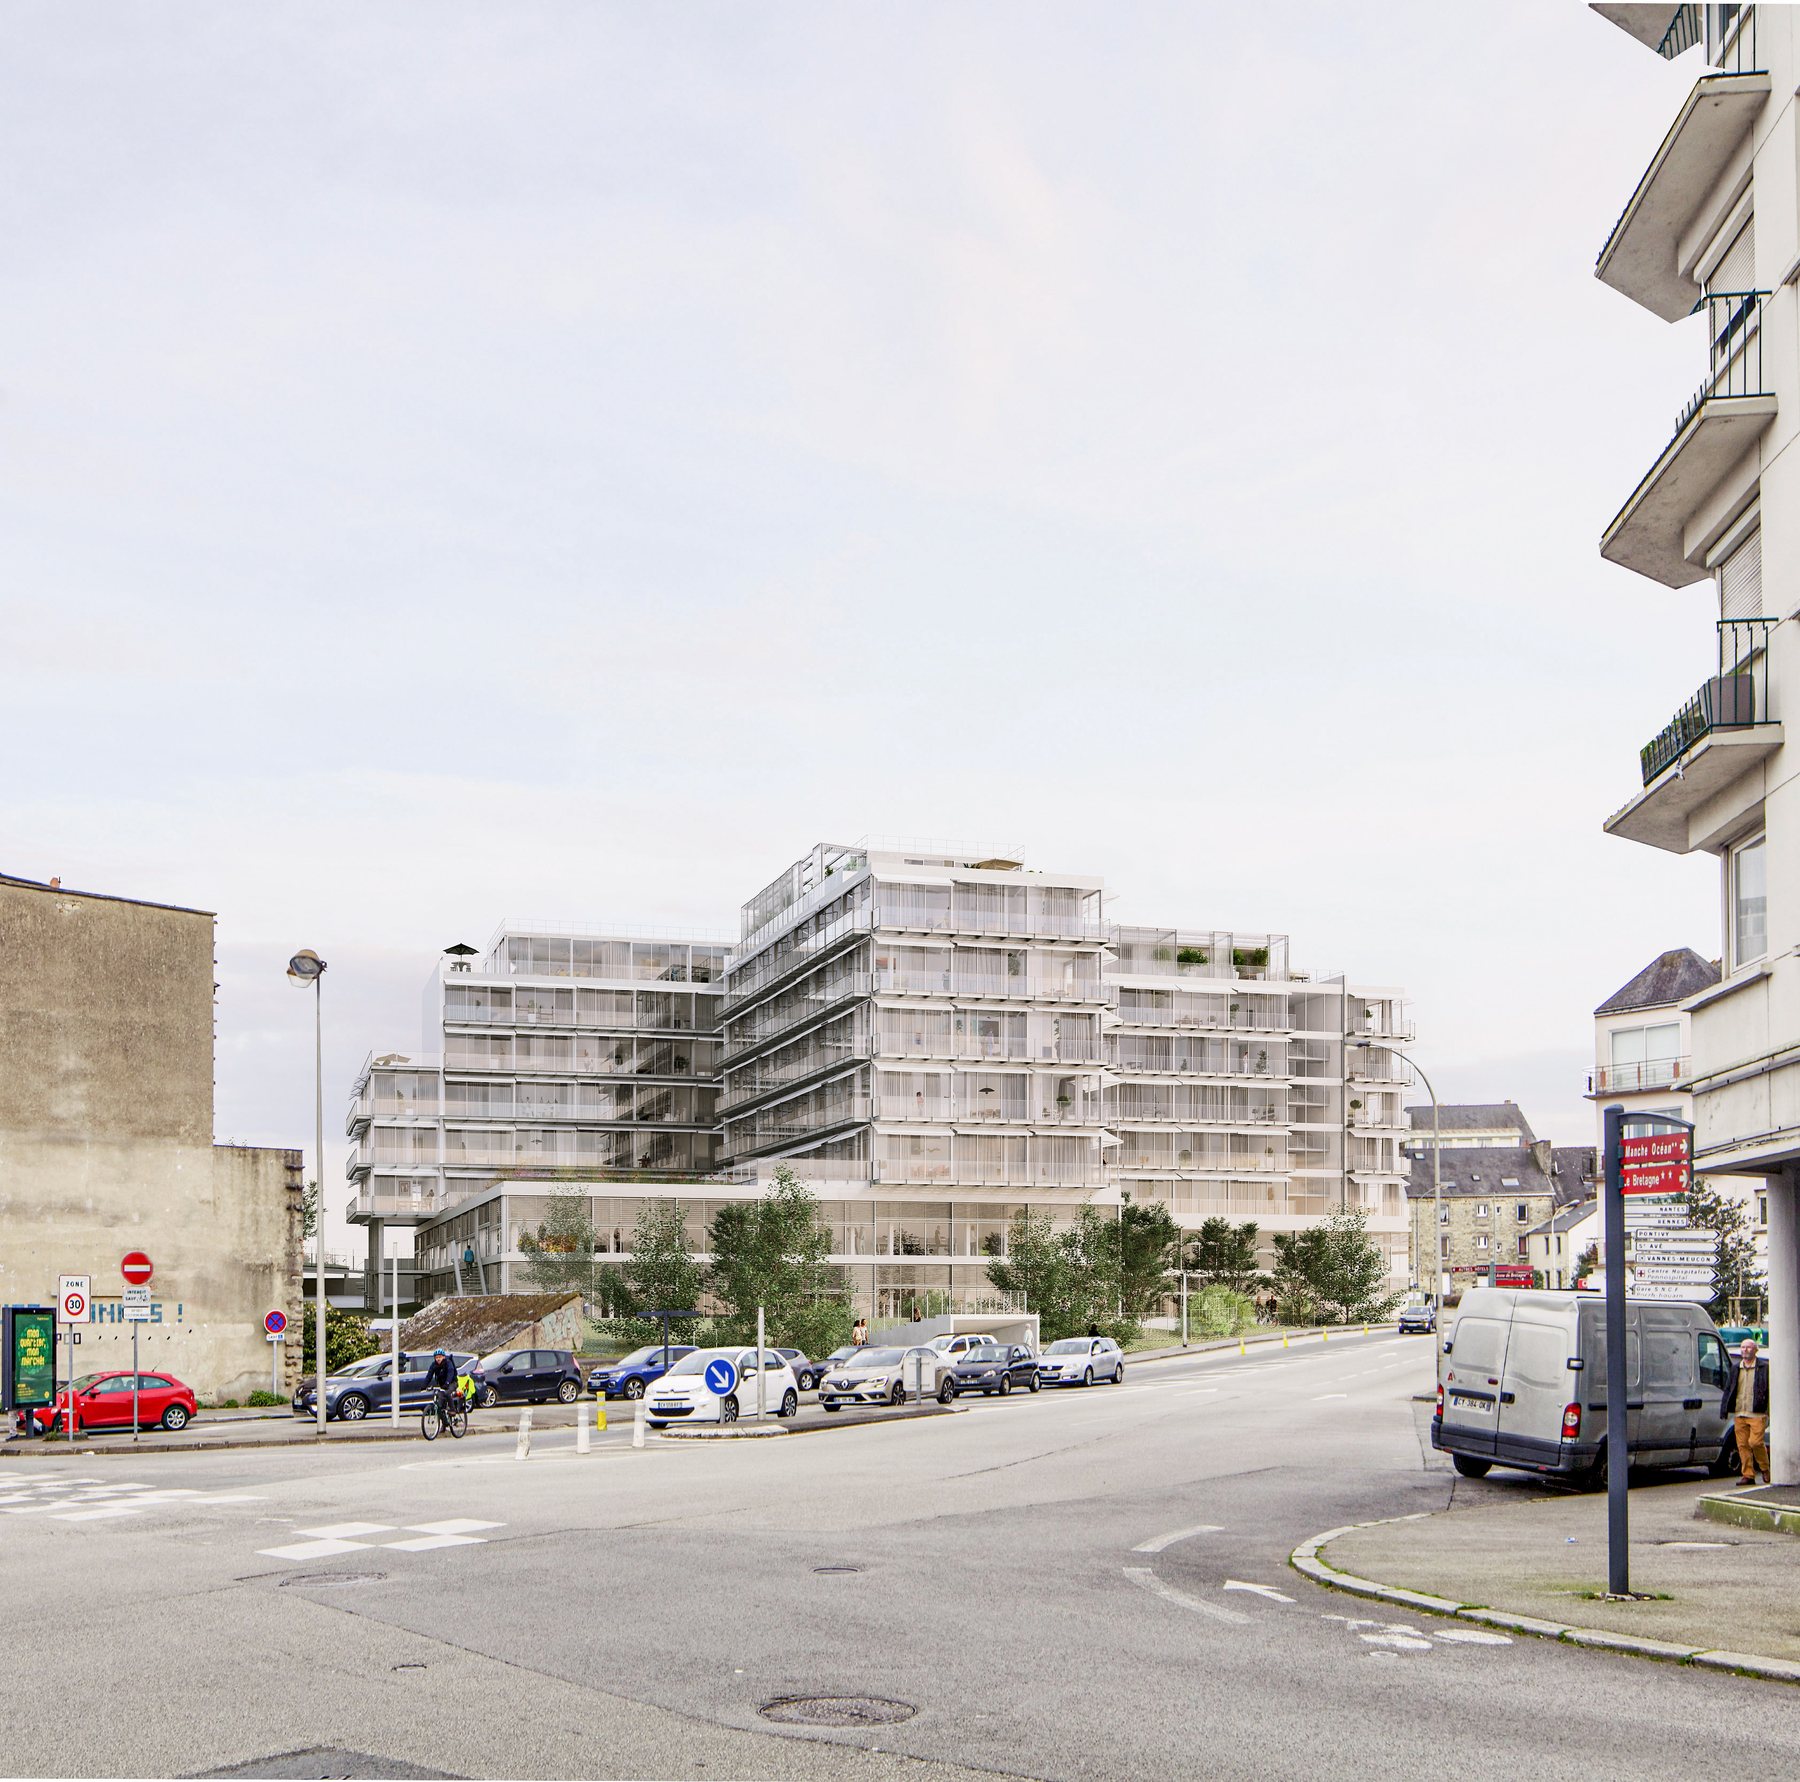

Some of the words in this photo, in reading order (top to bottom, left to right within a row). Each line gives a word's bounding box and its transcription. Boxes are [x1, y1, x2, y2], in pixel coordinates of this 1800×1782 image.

[1625, 1144, 1648, 1158] Manche
[1652, 1142, 1672, 1156] Océan
[1632, 1174, 1660, 1188] Bretagne
[69, 1300, 81, 1310] 30
